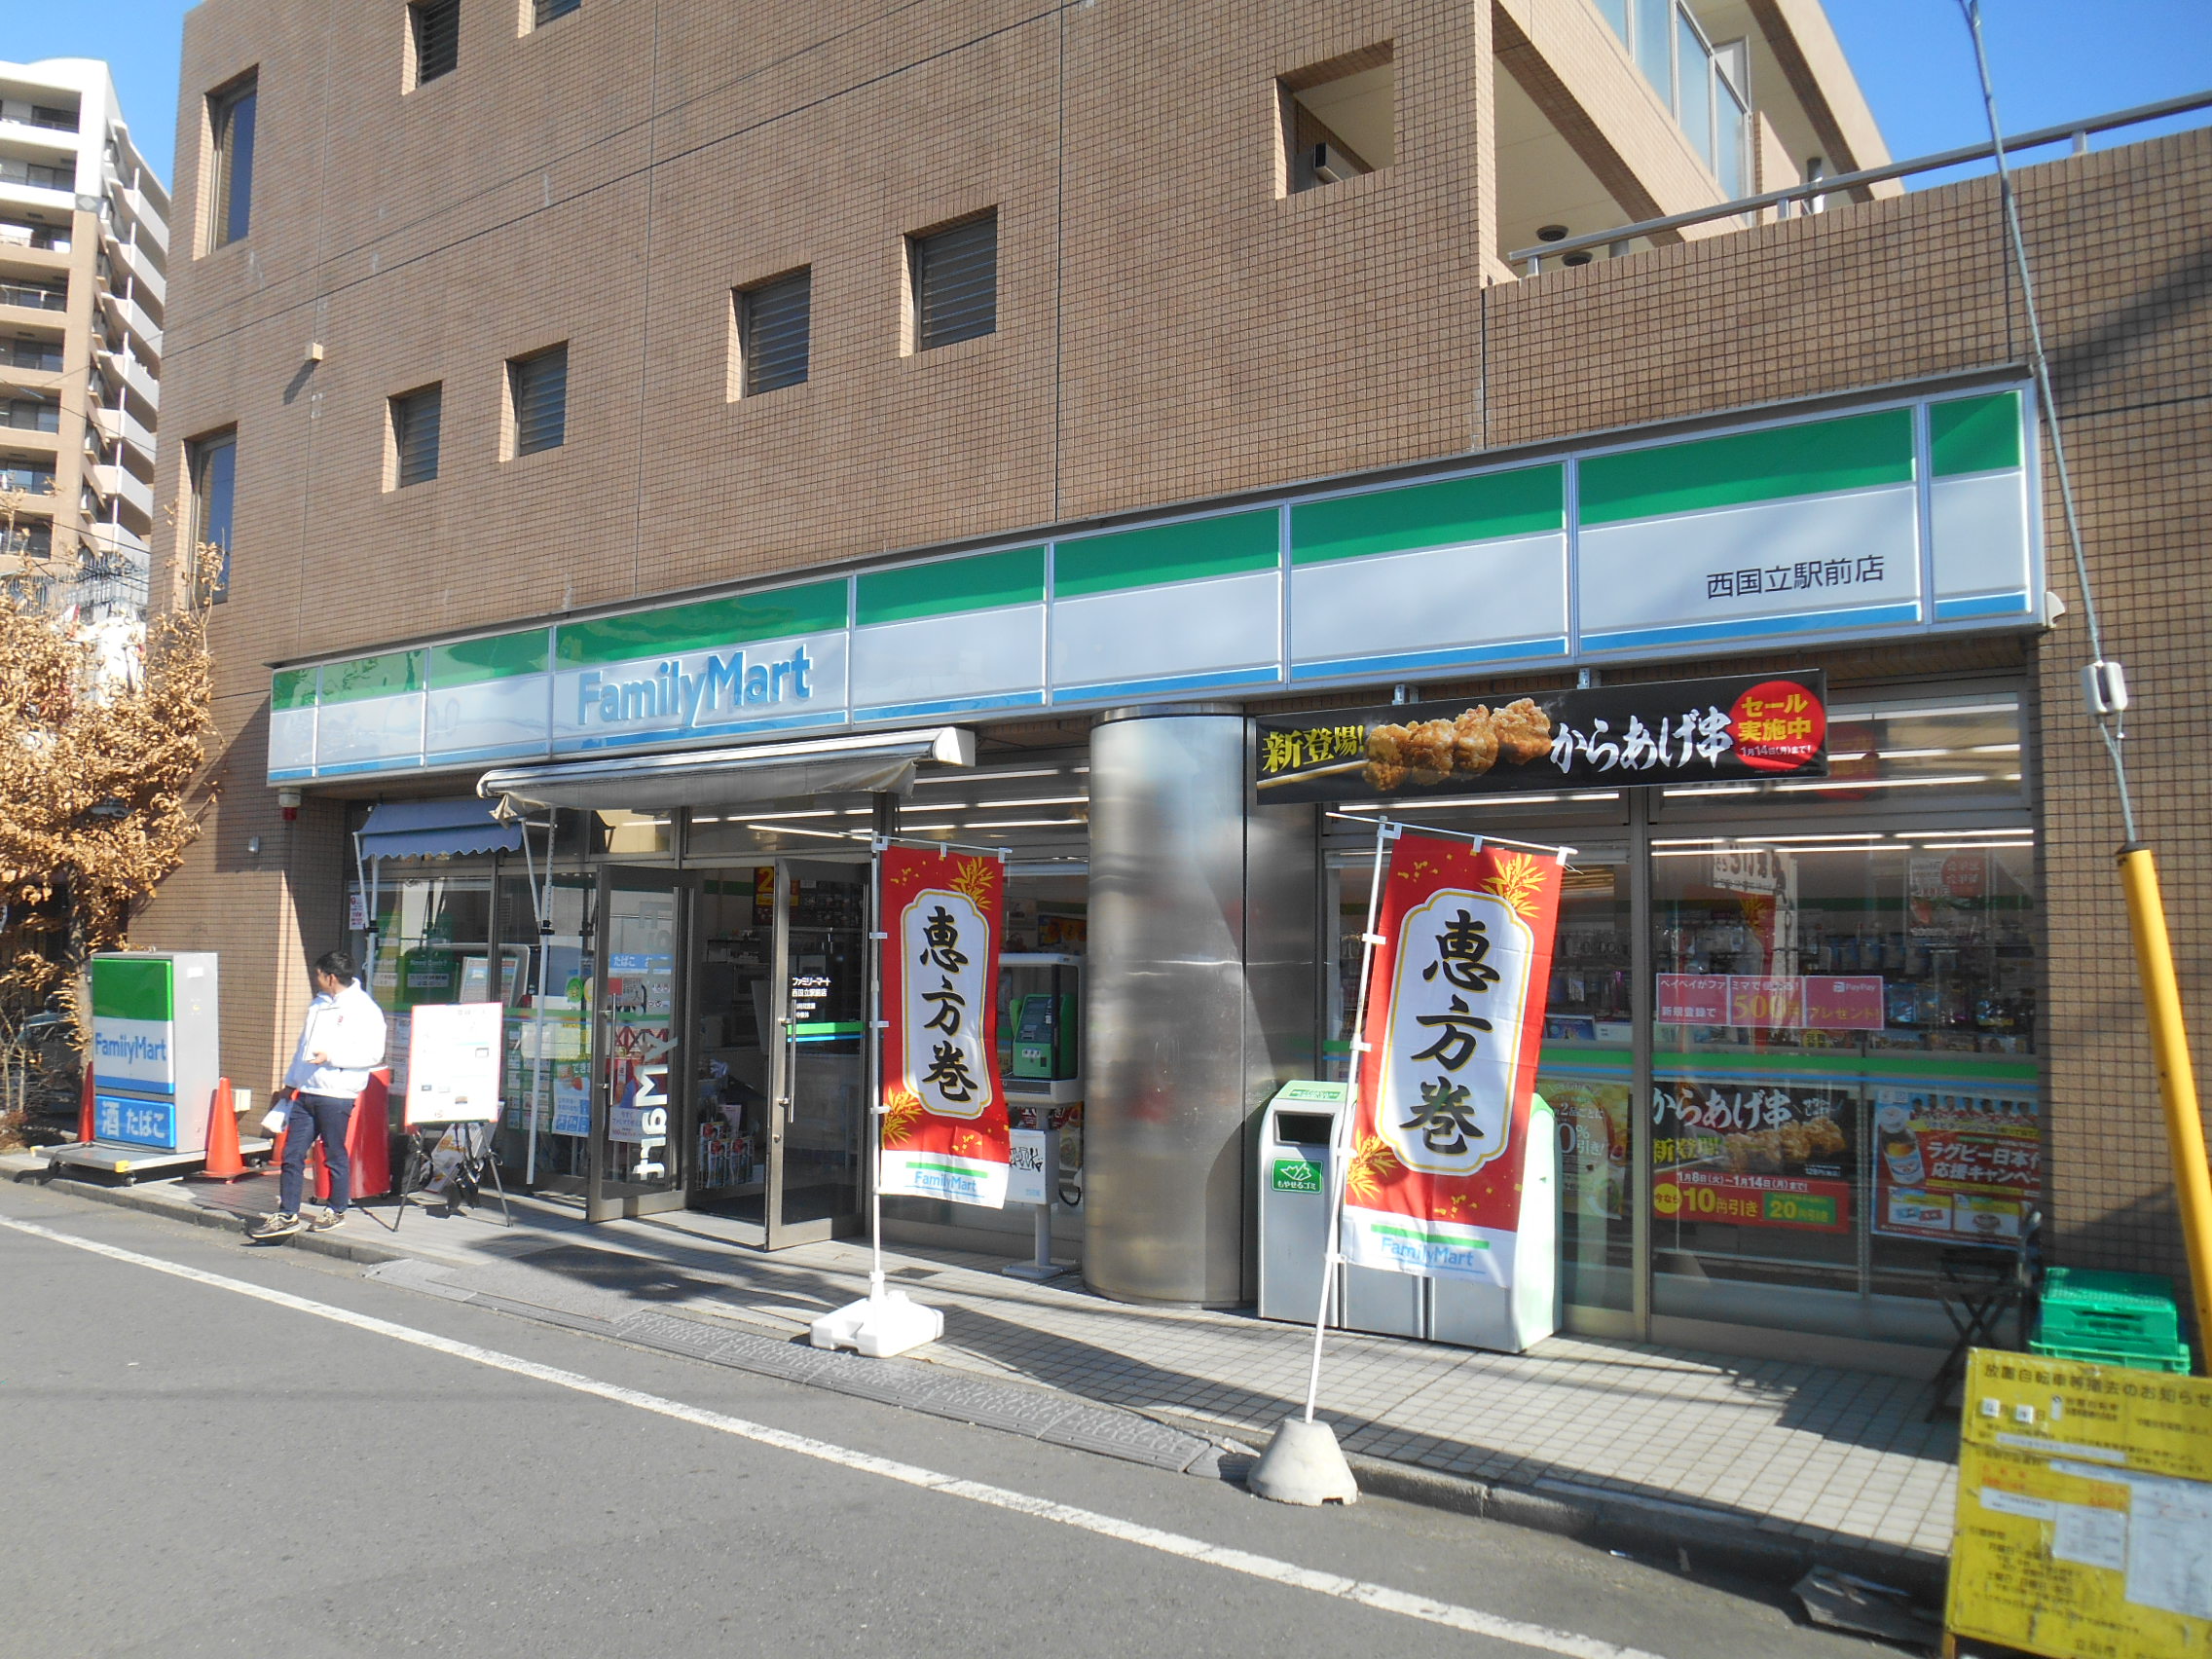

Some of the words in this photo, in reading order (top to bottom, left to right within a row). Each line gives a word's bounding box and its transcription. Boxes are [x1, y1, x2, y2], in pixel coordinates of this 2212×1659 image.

[1706, 554, 1885, 600] 西国立駅前店
[577, 644, 814, 728] FamilyMart
[1741, 693, 1808, 718] セール
[1262, 724, 1365, 773] 新登場!
[1550, 705, 1734, 774] からあげ串
[1738, 717, 1811, 742] 実施中
[920, 905, 978, 1102] 恵方巻
[94, 1032, 167, 1065] FamilyMart
[1399, 909, 1500, 1155] 恵方巻
[101, 1099, 121, 1138] 酒
[126, 1107, 166, 1139] たばこ
[1653, 1088, 1792, 1131] からあげ串
[914, 1170, 977, 1193] FamilyMart
[1277, 1180, 1316, 1191] もやせるゴミ
[1682, 1187, 1758, 1218] 10円引き
[1382, 1236, 1475, 1267] FamilyMart
